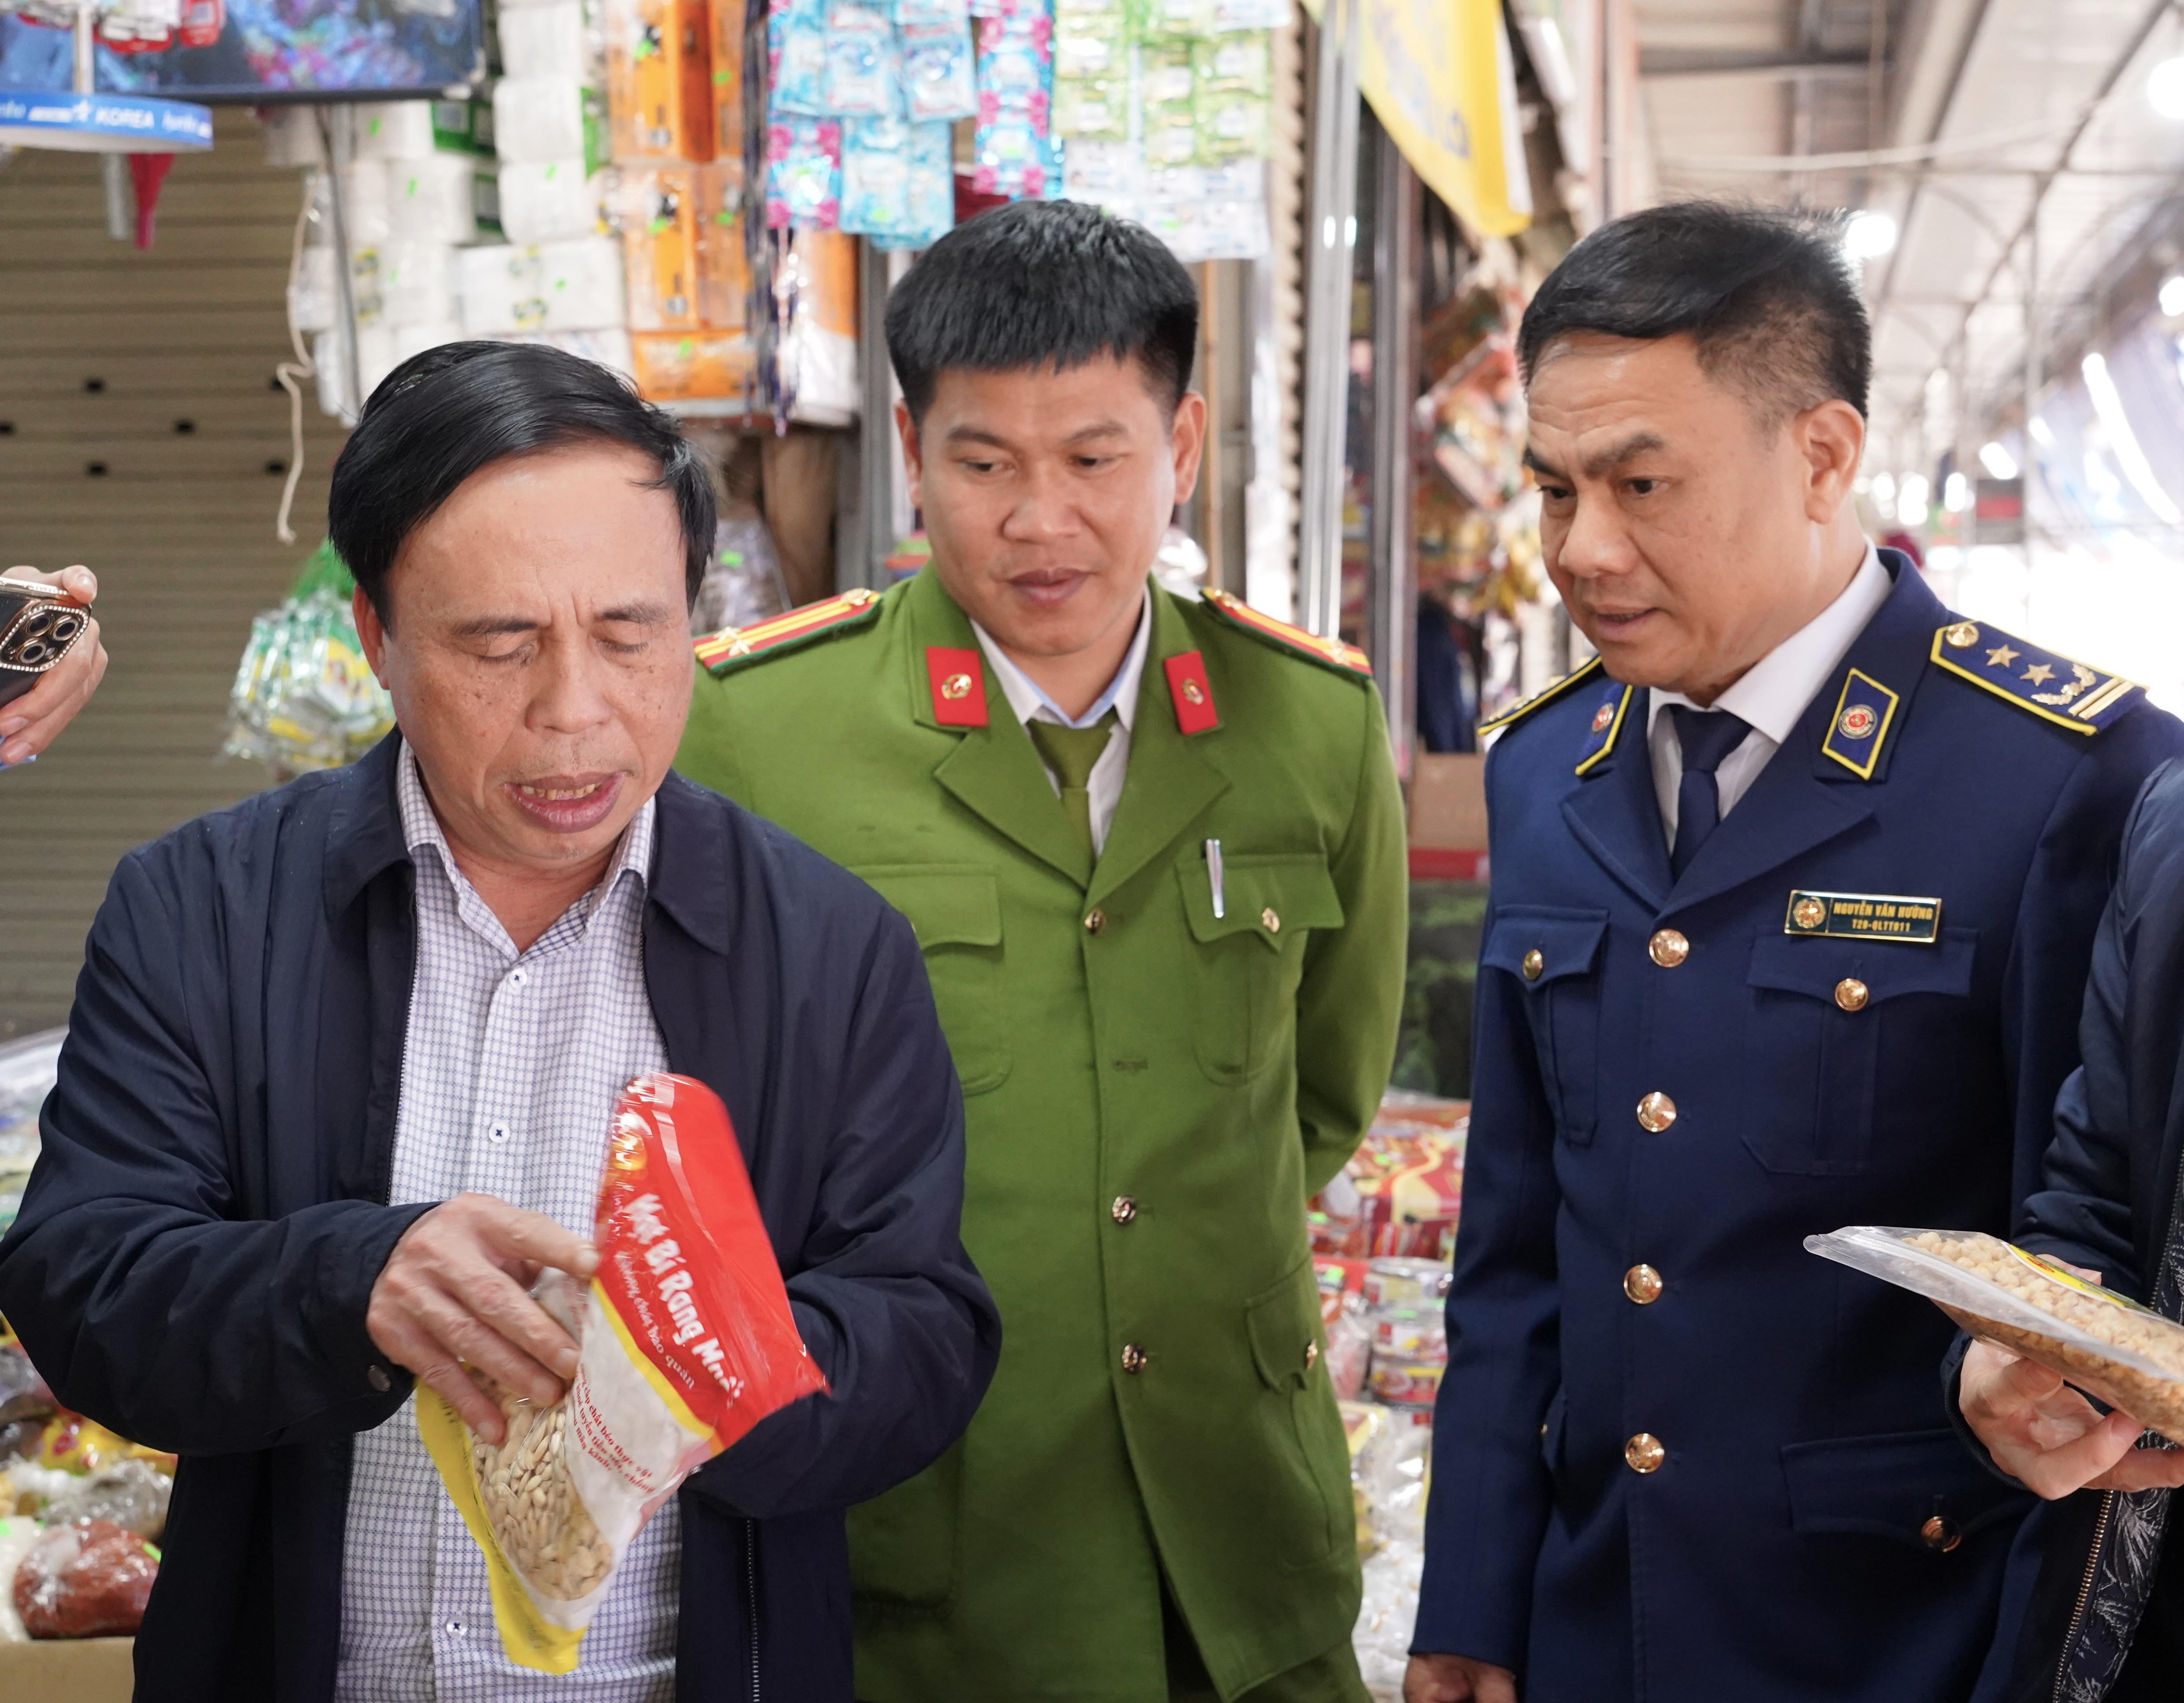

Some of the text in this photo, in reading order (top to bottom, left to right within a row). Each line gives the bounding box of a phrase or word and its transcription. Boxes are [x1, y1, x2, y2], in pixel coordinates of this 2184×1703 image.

[644, 1238, 688, 1276] Bí
[657, 1269, 705, 1346] Rang
[589, 1405, 602, 1427] chất
[600, 1425, 614, 1445] béo
